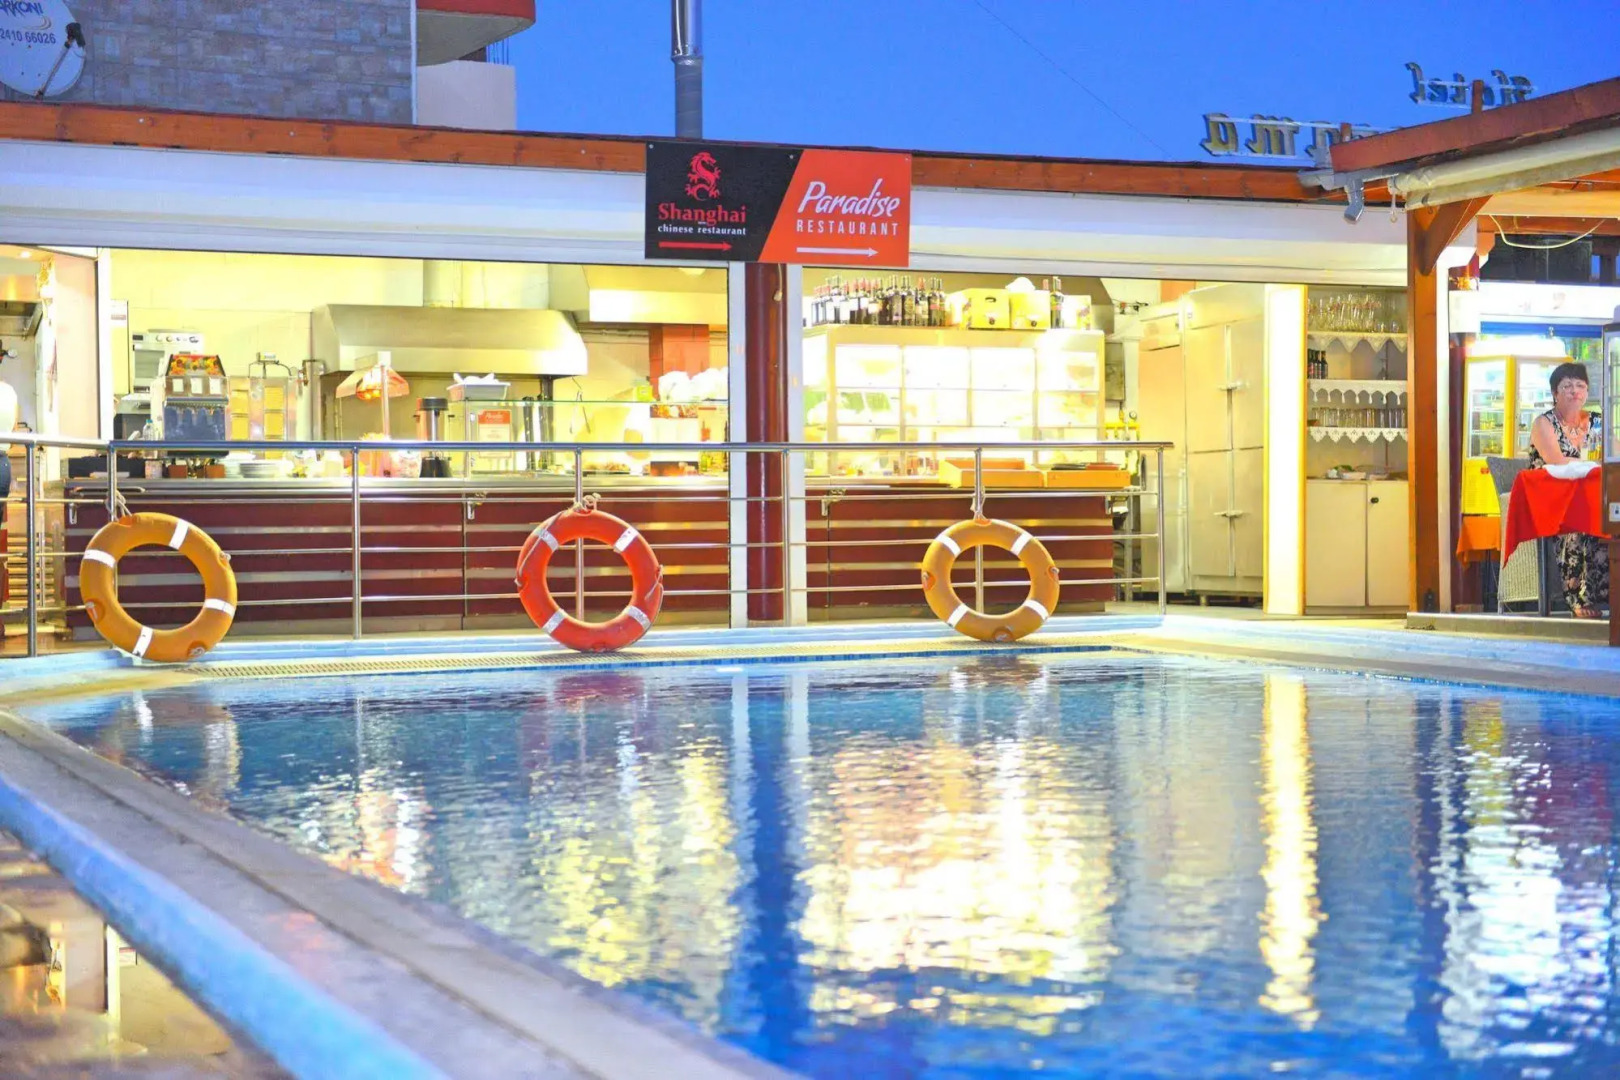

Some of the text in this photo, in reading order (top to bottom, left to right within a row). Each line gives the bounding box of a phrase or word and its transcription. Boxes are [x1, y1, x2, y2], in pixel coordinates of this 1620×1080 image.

[25, 31, 56, 44] 66026
[797, 178, 901, 218] Paradise
[658, 202, 746, 227] Shanghai
[657, 224, 747, 236] chinese restaurant
[796, 219, 899, 236] RESTAURANT
